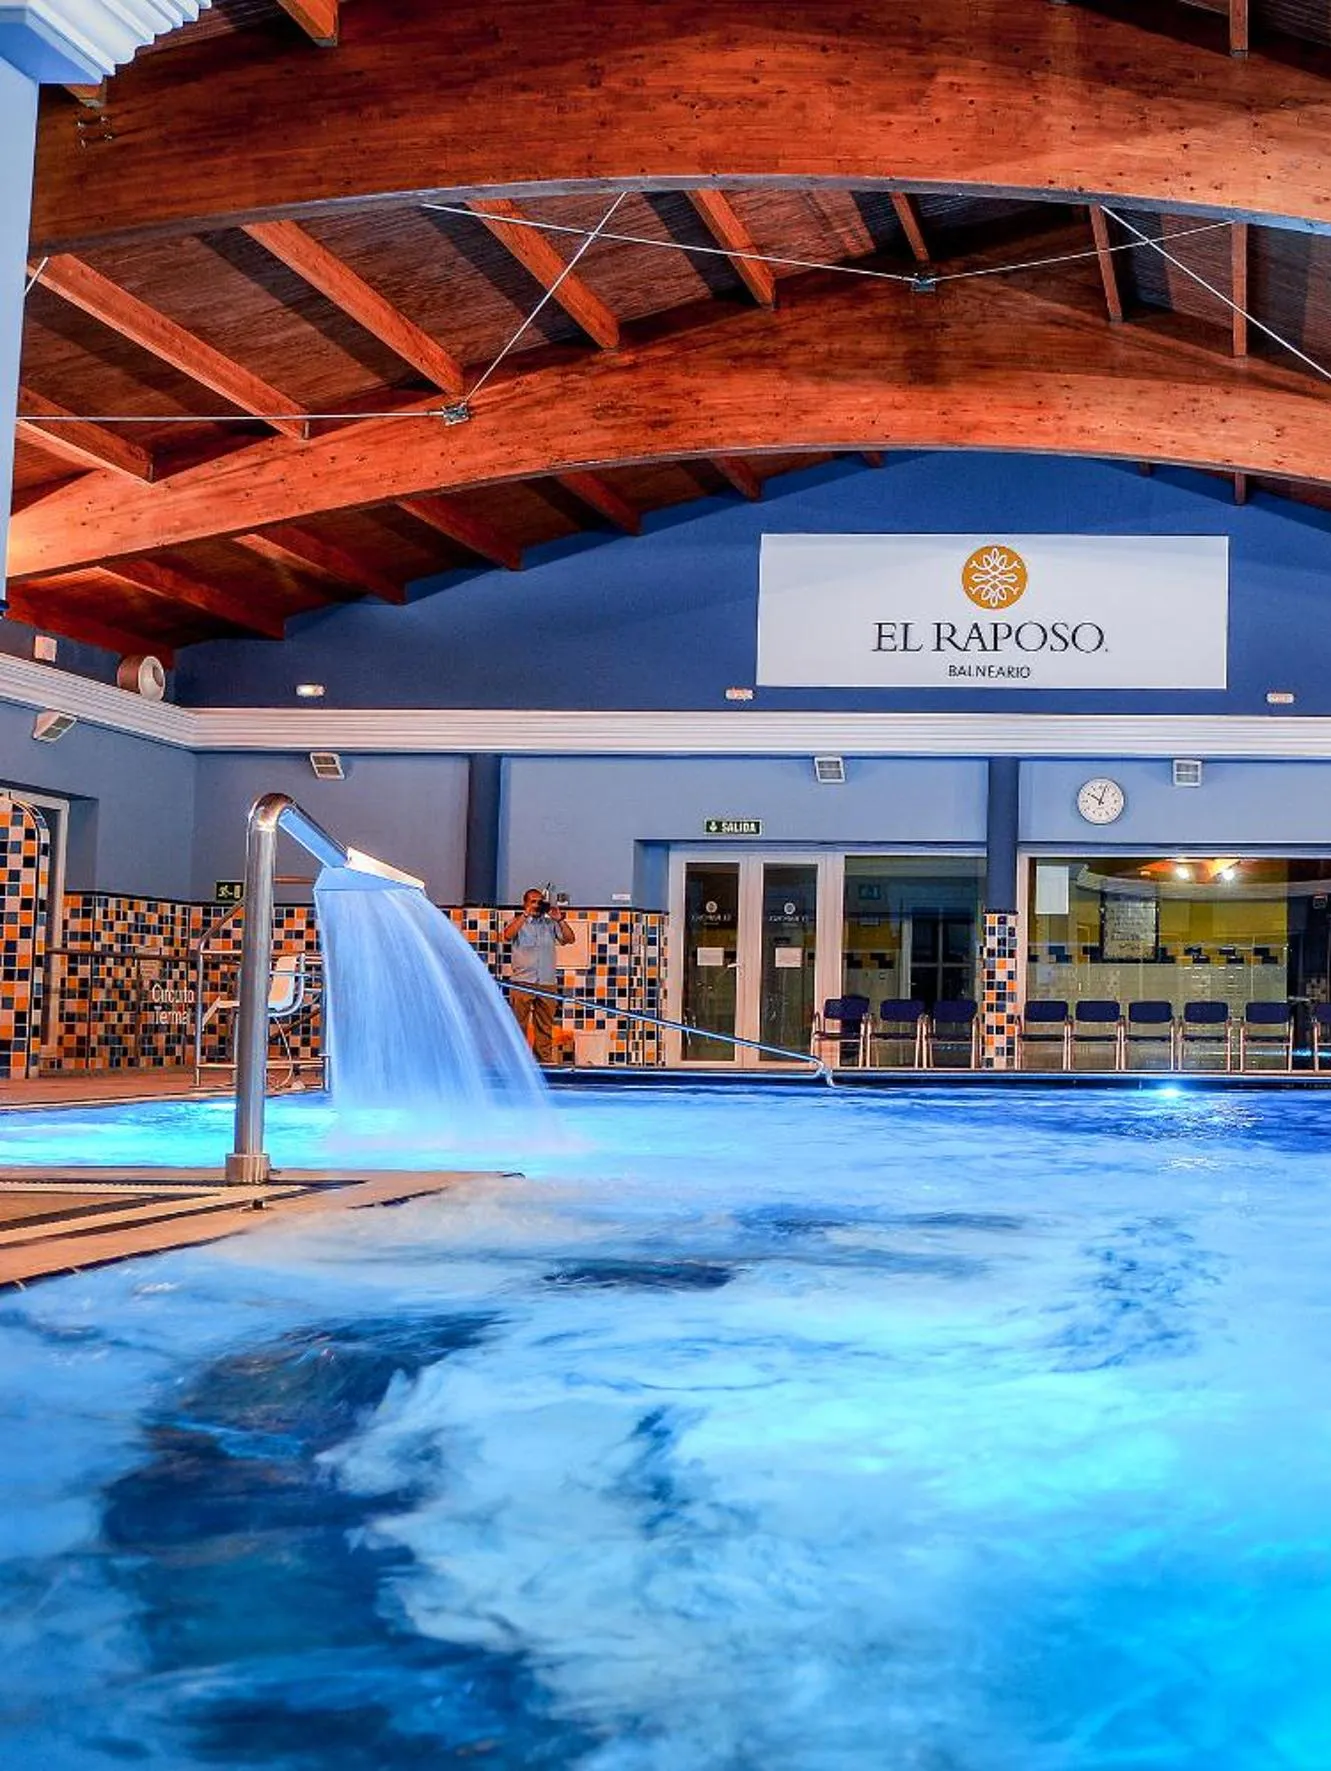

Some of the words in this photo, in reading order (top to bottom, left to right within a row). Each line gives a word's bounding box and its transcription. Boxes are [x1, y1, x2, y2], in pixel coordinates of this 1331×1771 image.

[872, 622, 923, 652] EL
[949, 664, 1031, 679] BALNEARIO
[721, 822, 757, 833] SALIDA
